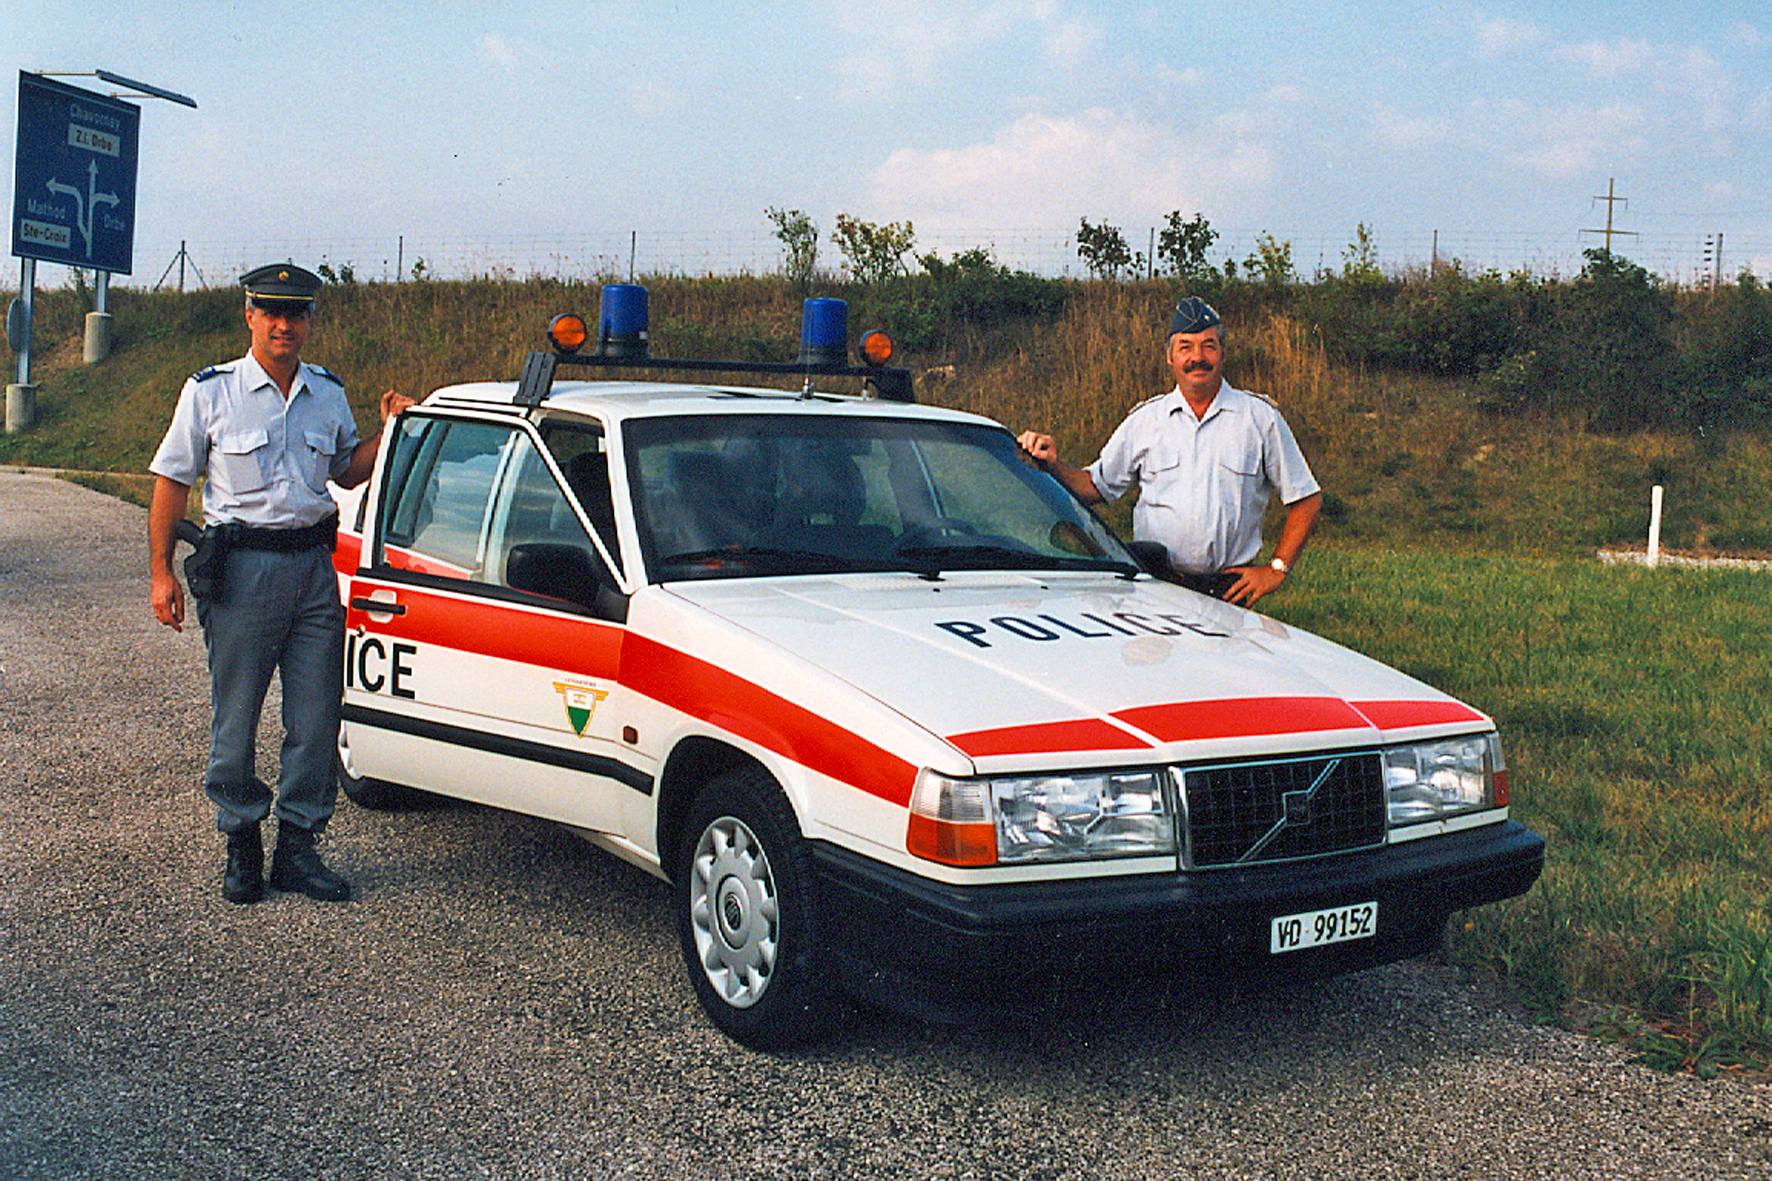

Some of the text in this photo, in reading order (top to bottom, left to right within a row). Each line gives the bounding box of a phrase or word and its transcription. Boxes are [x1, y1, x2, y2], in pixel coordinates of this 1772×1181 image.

[91, 133, 113, 152] Orbe
[27, 198, 66, 219] Mathod
[23, 222, 68, 243] Ste-Croix
[934, 612, 1231, 648] POLICE
[1278, 906, 1373, 948] VD 99152
